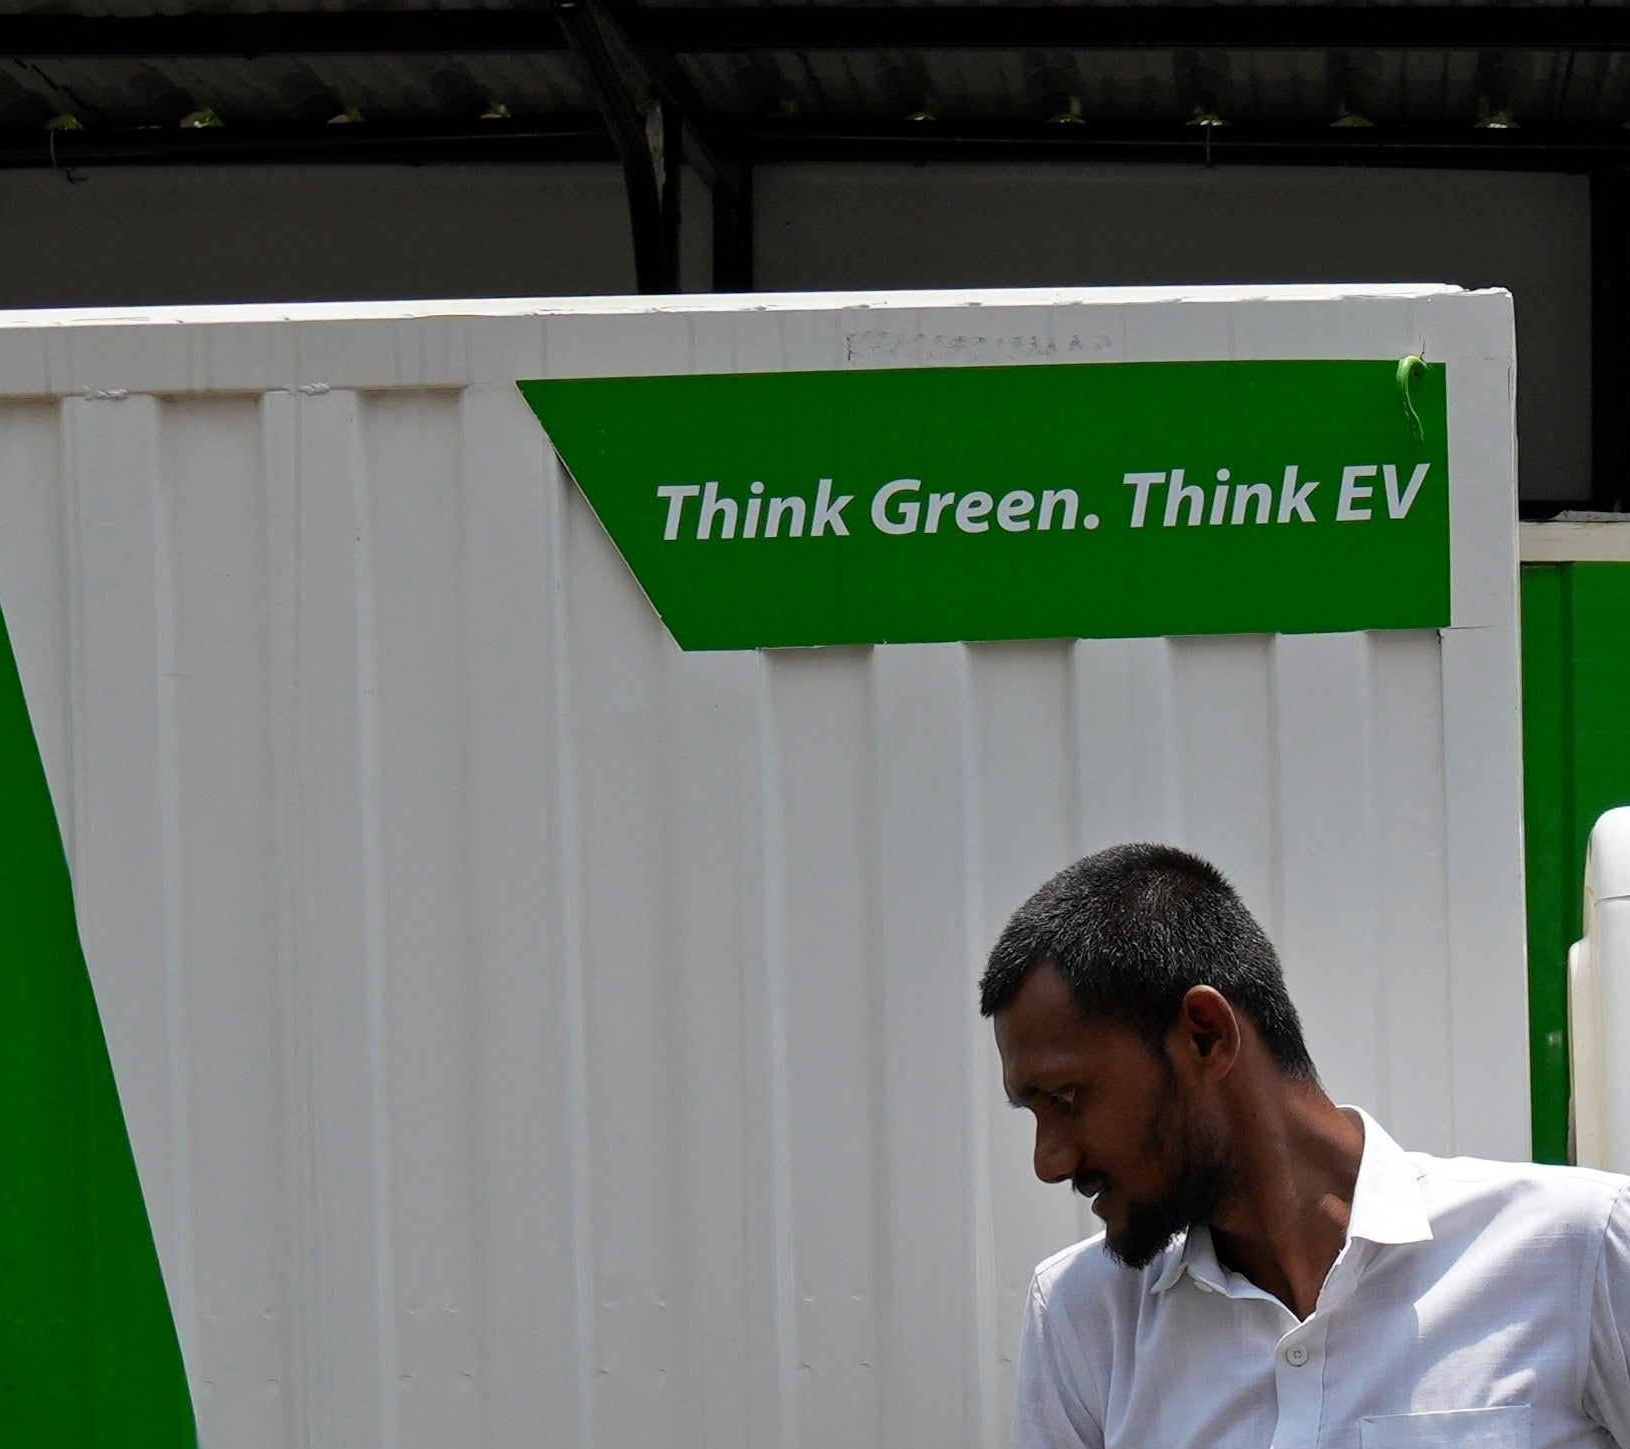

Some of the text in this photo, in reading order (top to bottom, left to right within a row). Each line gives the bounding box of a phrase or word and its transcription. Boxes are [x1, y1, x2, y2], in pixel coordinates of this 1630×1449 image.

[656, 462, 1431, 541] Think Green. Think EV
